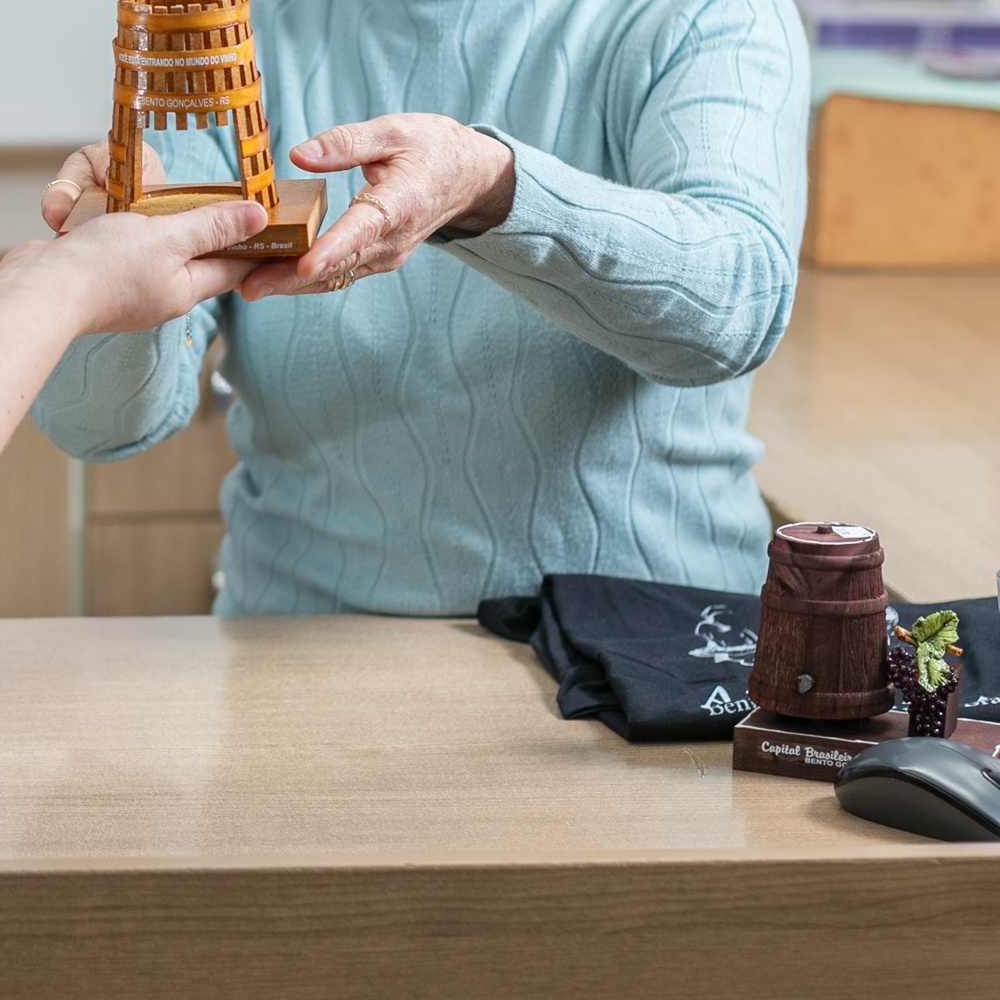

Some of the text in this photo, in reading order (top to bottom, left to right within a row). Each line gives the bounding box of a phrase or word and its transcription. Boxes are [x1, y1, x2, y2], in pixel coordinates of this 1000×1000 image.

[141, 57, 174, 67] ENTRANDO
[174, 57, 185, 67] NO
[185, 56, 210, 67] MUNDO
[210, 55, 219, 65] DO
[220, 52, 237, 63] VINHO
[140, 97, 165, 107] BENTO
[166, 97, 214, 110] GONÇALVES
[219, 95, 230, 106] RS
[253, 242, 265, 250] RS
[271, 241, 293, 250] Brasil
[761, 740, 853, 762] Capital Brasileir
[804, 757, 834, 767] BENTO
